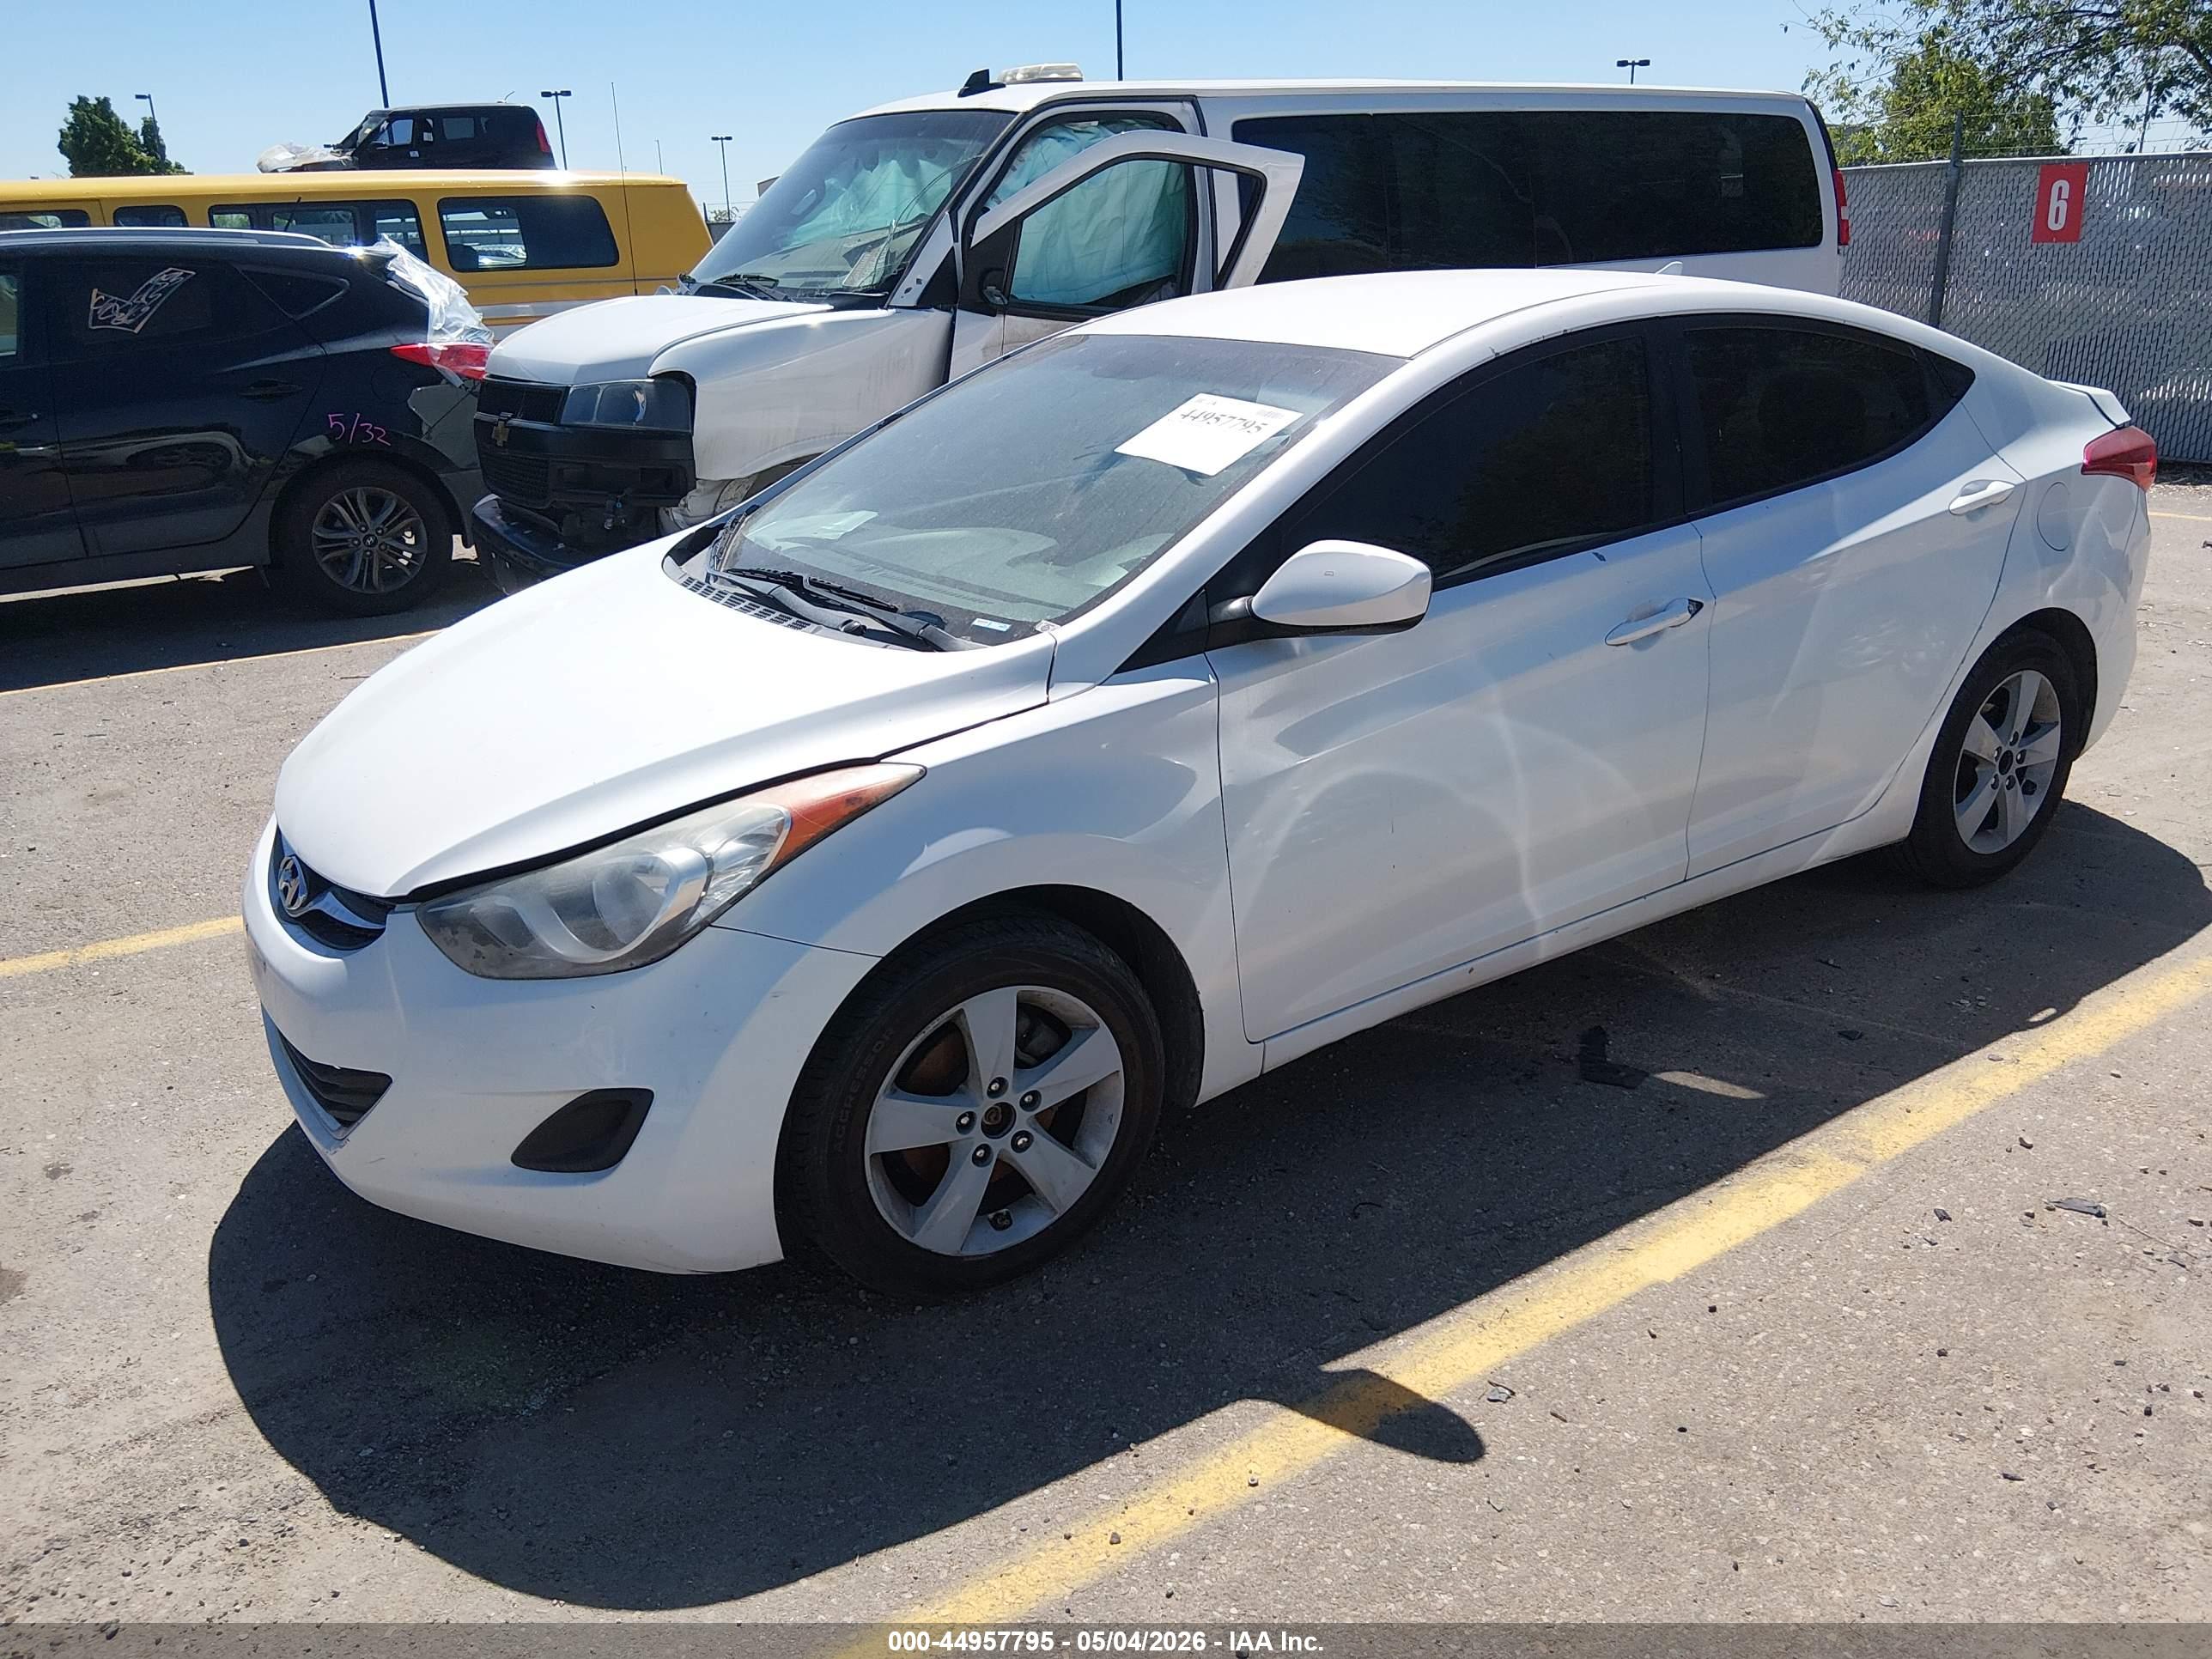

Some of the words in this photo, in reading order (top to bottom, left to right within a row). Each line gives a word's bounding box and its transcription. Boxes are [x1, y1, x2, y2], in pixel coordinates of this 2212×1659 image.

[2048, 179, 2070, 231] 6
[328, 413, 392, 446] 5/32
[1181, 409, 1268, 433] 44957795
